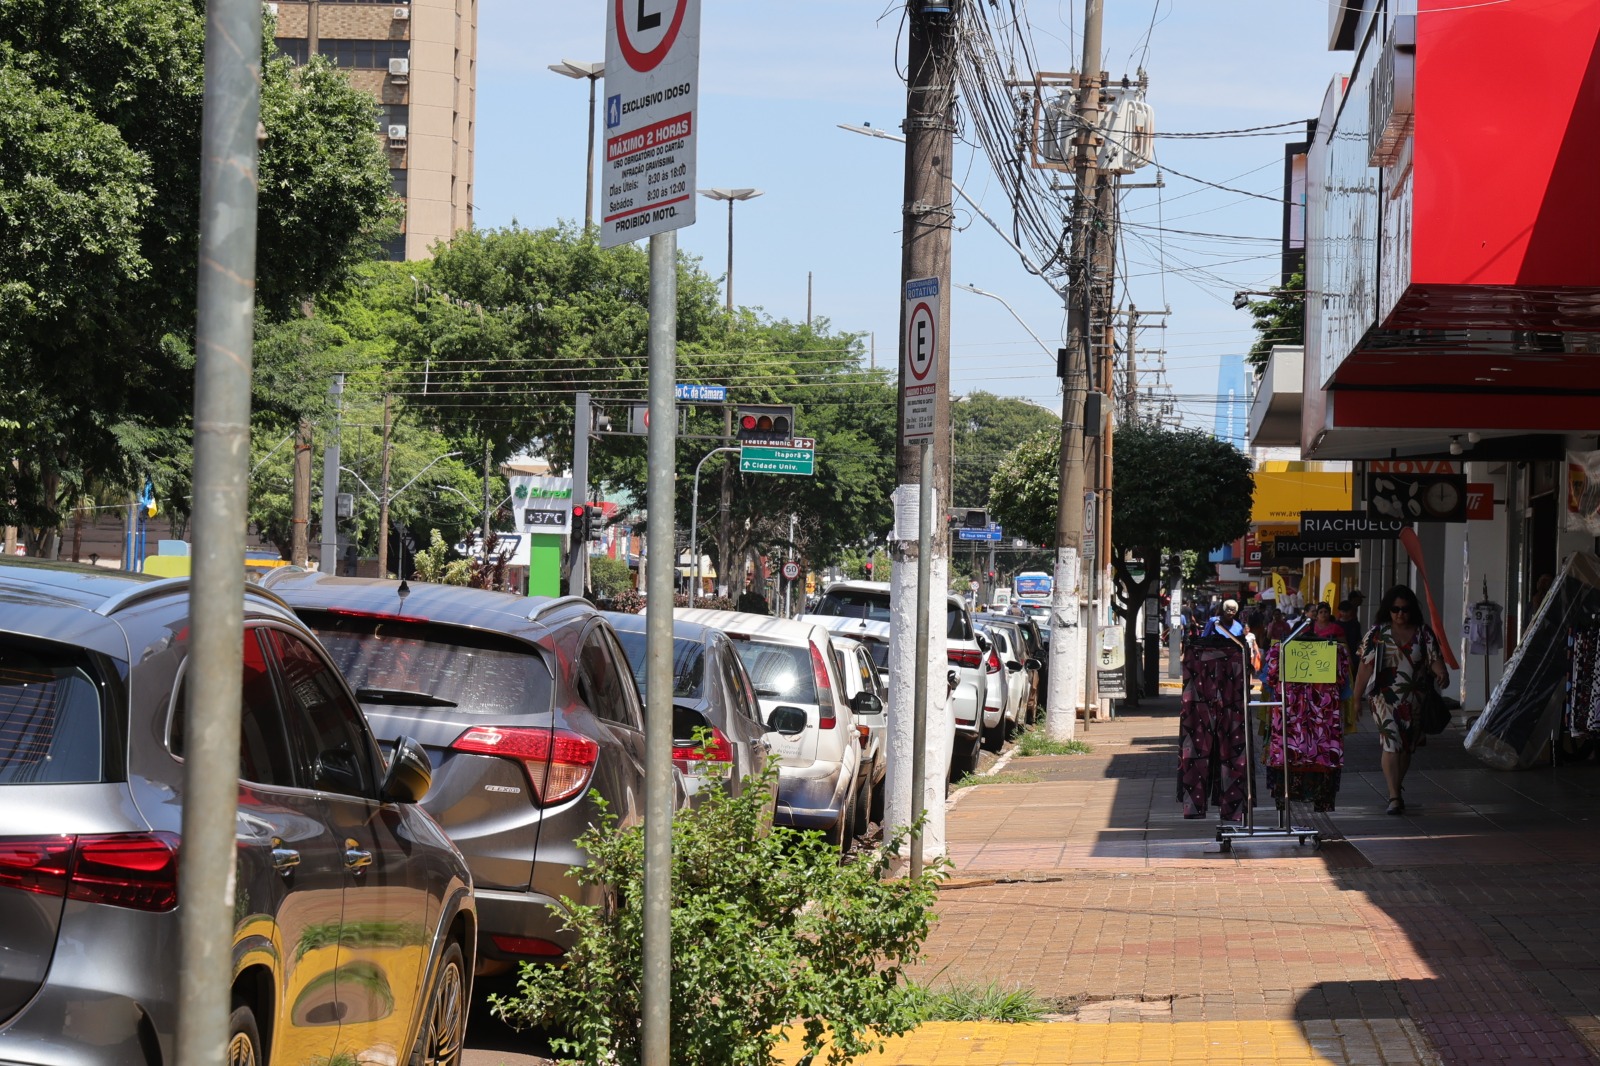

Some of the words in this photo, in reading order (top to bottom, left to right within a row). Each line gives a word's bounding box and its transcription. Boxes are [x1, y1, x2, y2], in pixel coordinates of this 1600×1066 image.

[622, 91, 663, 115] EXCLUSIVO
[664, 82, 691, 101] IDOSO
[609, 134, 645, 158] MÁXIMO
[646, 131, 654, 145] 2
[655, 120, 688, 142] HORAS
[613, 159, 624, 169] USO
[624, 148, 656, 166] OBRIGATÓRIO
[656, 146, 664, 156] DO
[664, 139, 685, 154] CARTÃO
[609, 184, 622, 197] Dias
[647, 173, 661, 185] 8:30
[670, 163, 687, 178] 18:00
[646, 190, 660, 201] 8:30
[669, 181, 686, 194] 12:00
[615, 212, 651, 232] PROIBIDO
[907, 285, 938, 299] ROTATIVO
[917, 320, 926, 362] E
[691, 387, 698, 398] da
[699, 386, 724, 399] Câmara
[752, 461, 777, 470] Cidade
[778, 461, 798, 471] Univ.
[1370, 460, 1453, 474] NOVA
[1304, 519, 1402, 531] RIACHUELO
[1276, 542, 1353, 552] RIACHUELO
[785, 565, 797, 573] 50
